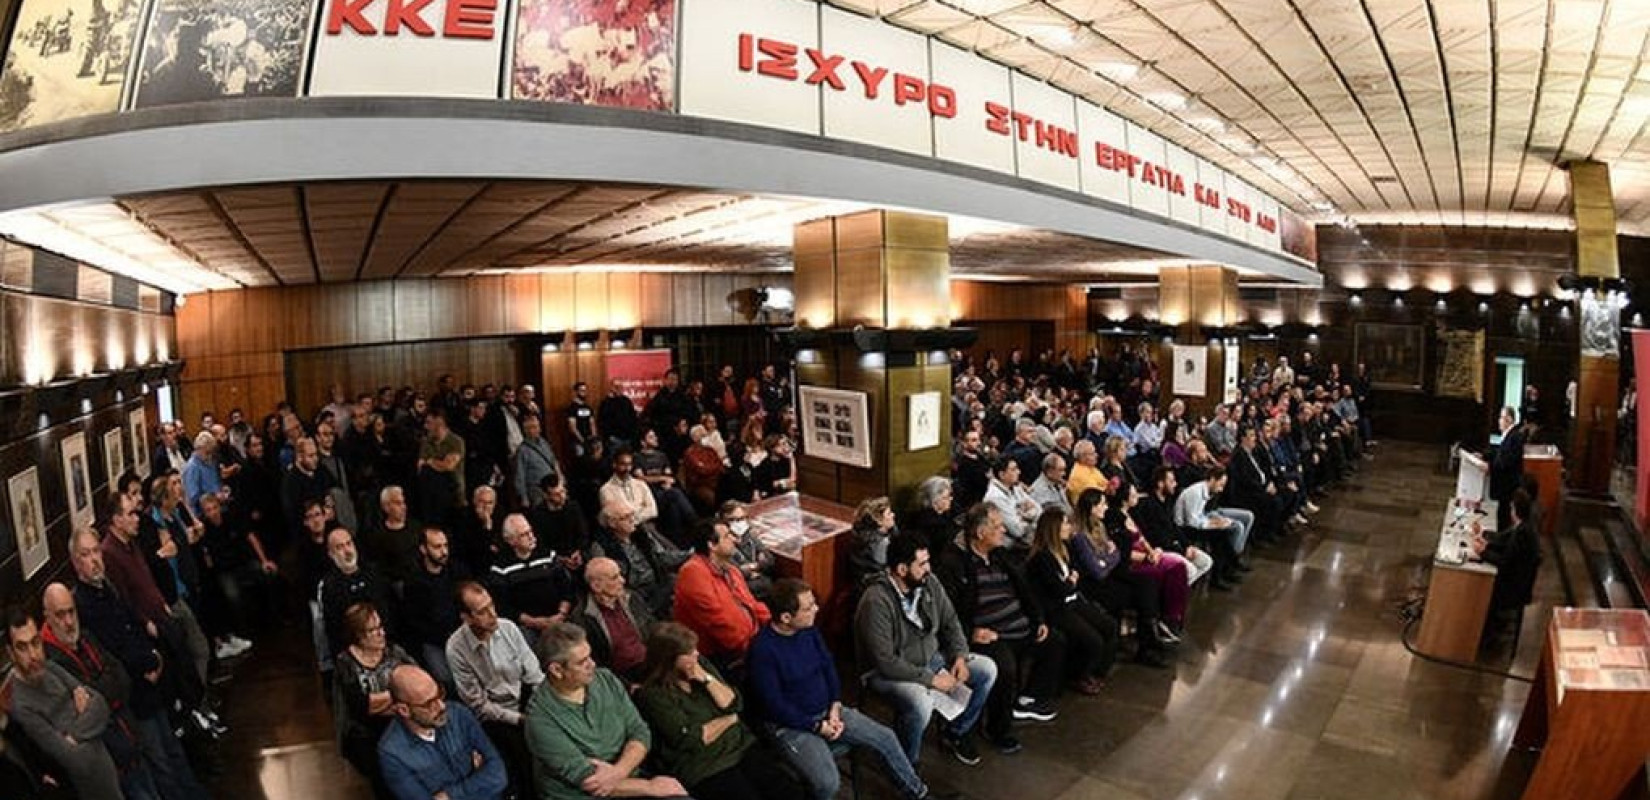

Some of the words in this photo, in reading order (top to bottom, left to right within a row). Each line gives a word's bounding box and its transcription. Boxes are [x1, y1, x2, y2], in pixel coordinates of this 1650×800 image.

[326, 0, 498, 39] ΚΚΕ
[738, 32, 957, 119] ΙΣΧΥΡΟ
[985, 101, 1079, 158] ΣΤΗΝ
[1095, 141, 1185, 197] ΕΡΓΑΤΙΑ
[1194, 183, 1220, 210] ΚΑΙ
